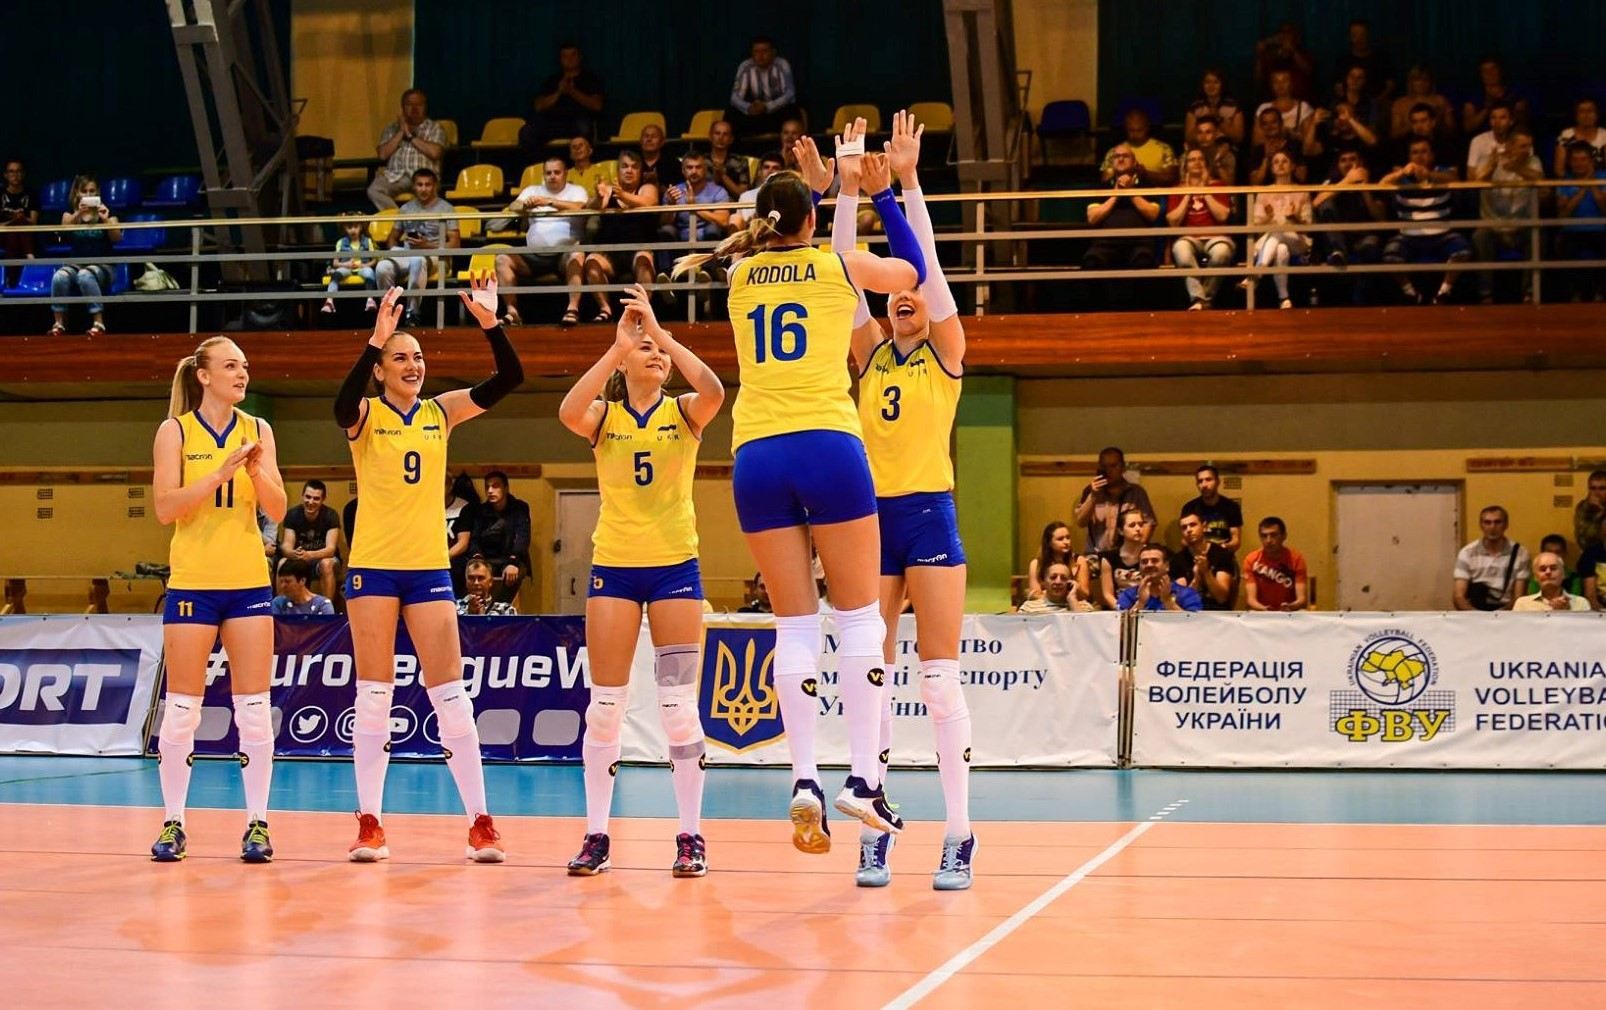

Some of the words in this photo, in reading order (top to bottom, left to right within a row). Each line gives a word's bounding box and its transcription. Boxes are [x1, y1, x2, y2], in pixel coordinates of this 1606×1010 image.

[747, 264, 816, 285] KODOLA
[747, 303, 808, 364] 16
[882, 386, 901, 421] 3
[404, 451, 421, 484] 9
[634, 451, 653, 486] 5
[352, 575, 362, 589] 9
[1252, 561, 1292, 588] KANGO
[177, 600, 193, 617] 11
[1156, 660, 1303, 681] ФЕДЕРАЦІЯ
[1149, 682, 1307, 704] ВОЛЕЙБОЛУ
[1175, 708, 1281, 730] УКРАЇНИ
[1335, 708, 1451, 742] ФВУ
[1476, 713, 1606, 731] FEDERATI
